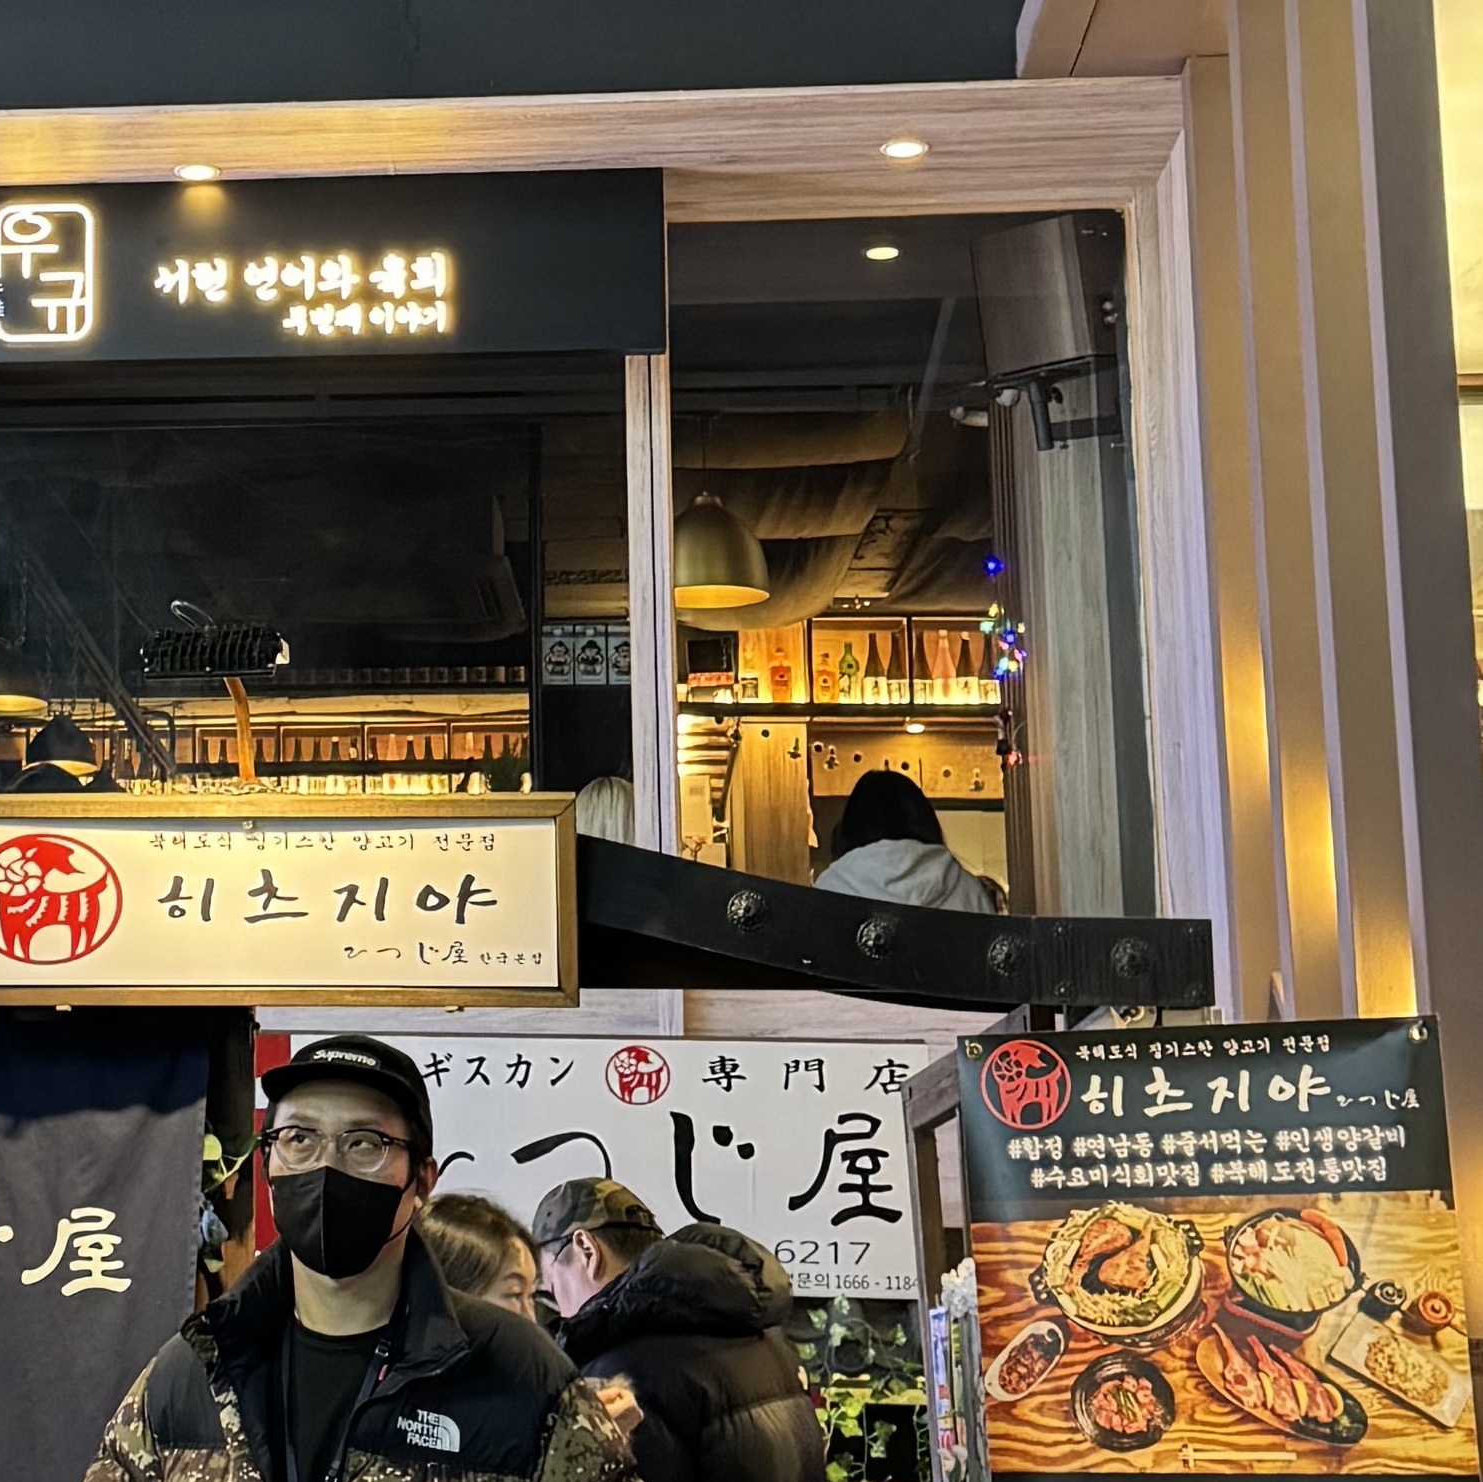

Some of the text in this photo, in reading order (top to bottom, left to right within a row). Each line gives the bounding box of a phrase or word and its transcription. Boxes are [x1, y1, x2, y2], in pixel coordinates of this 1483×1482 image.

[434, 832, 495, 851] 전문점
[157, 868, 497, 925] 히츠지야
[343, 941, 468, 964] ひつじ屋
[702, 1055, 910, 1095] 専門店
[1080, 1063, 1331, 1116] 히츠지야
[1007, 1137, 1063, 1160] #합정
[1073, 1133, 1153, 1159] #연남동
[1276, 1124, 1406, 1153] #인생양갈비
[438, 1111, 903, 1227] つじ屋
[790, 1272, 830, 1289] 문의
[836, 1275, 870, 1290] 1666
[407, 1432, 436, 1448] FACE
